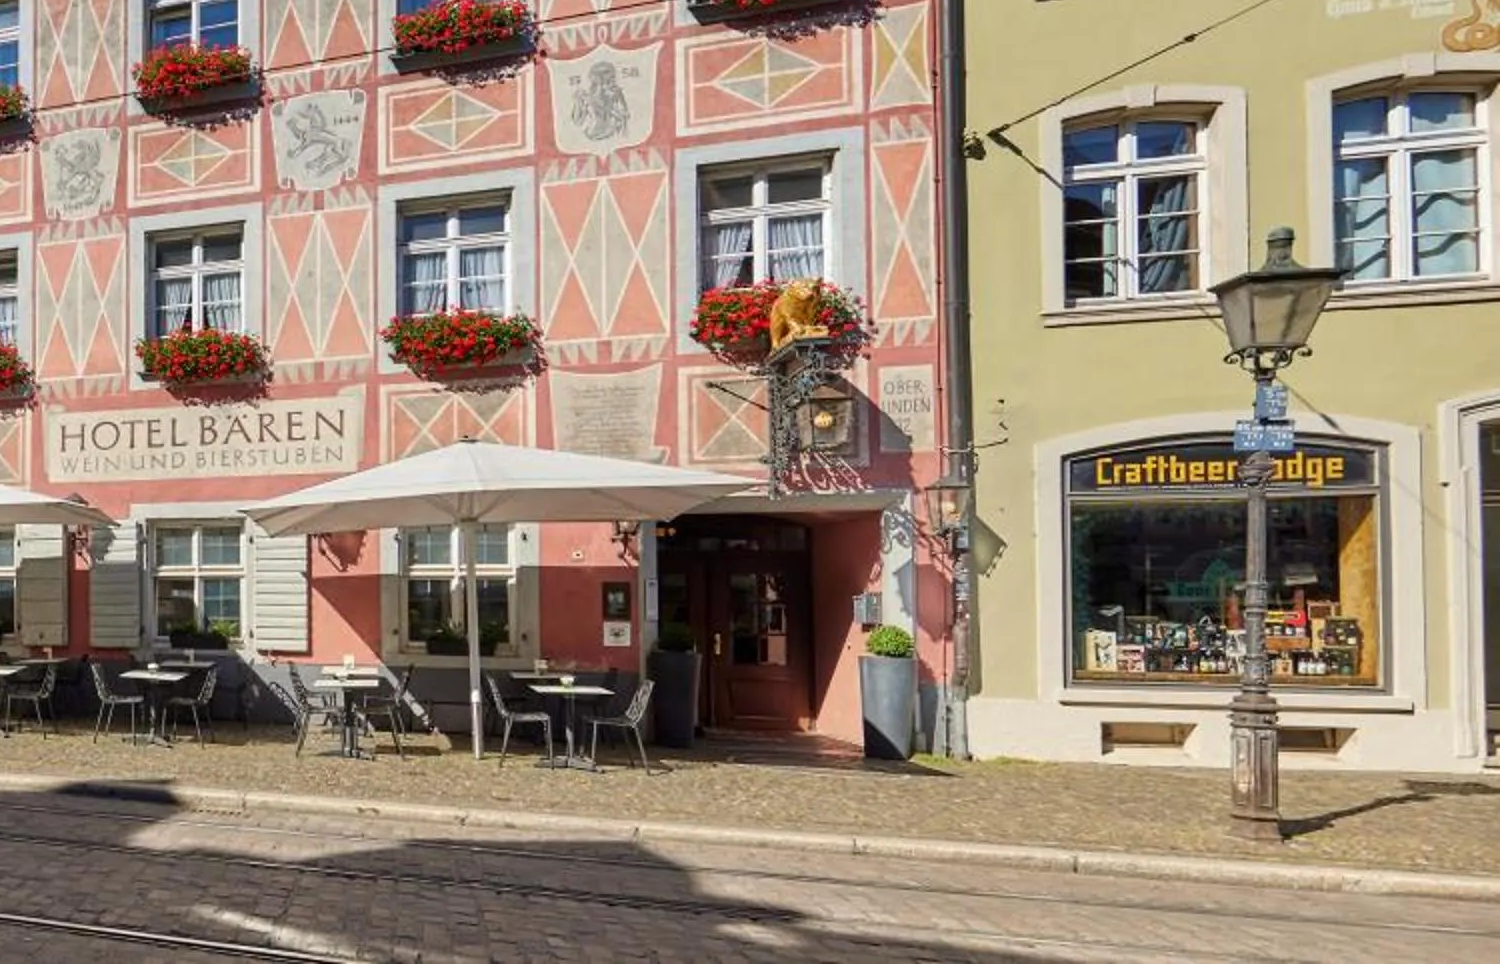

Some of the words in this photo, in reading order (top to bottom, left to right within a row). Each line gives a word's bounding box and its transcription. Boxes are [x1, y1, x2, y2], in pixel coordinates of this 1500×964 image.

[59, 416, 188, 453] HOTEL
[199, 409, 346, 447] BÄREN
[130, 451, 186, 471] UND
[195, 444, 344, 467] BIERSTUBEN
[1096, 451, 1239, 485] Craftbeer
[1266, 451, 1344, 486] odge
